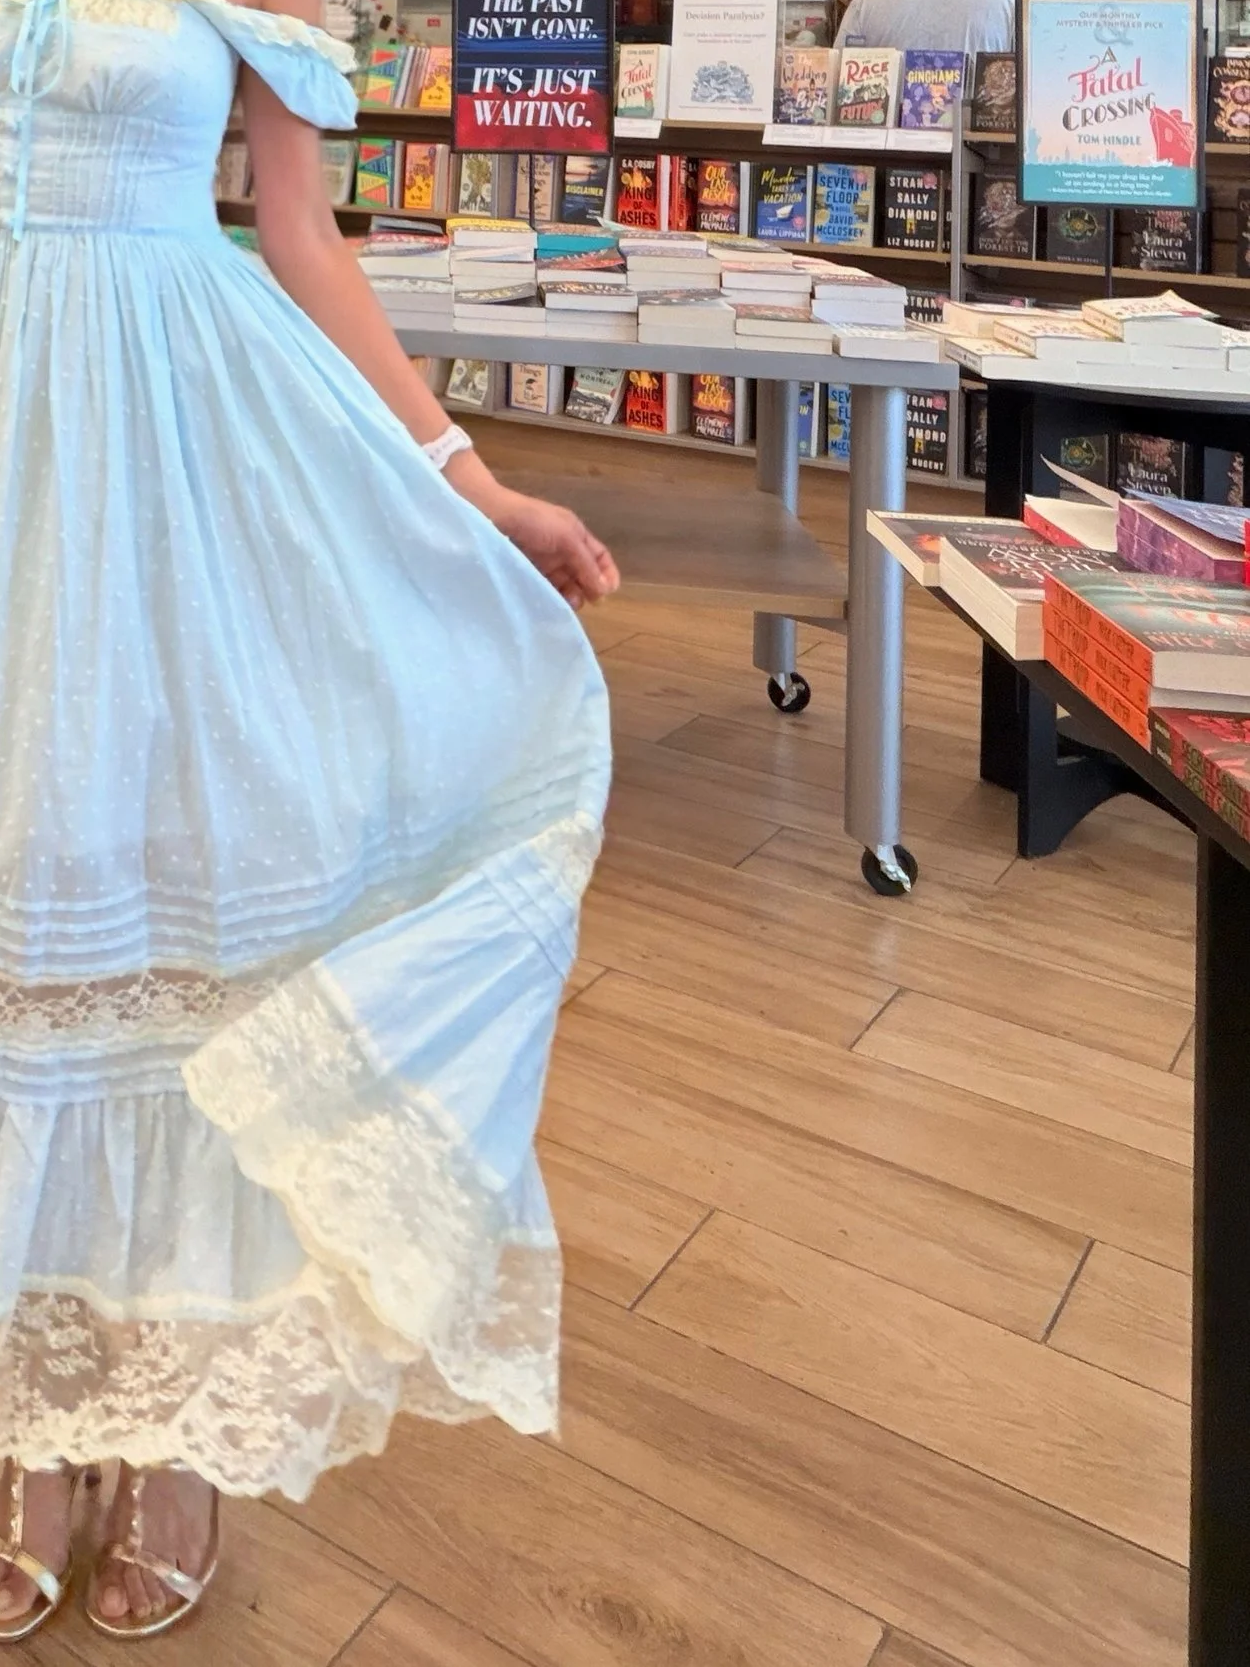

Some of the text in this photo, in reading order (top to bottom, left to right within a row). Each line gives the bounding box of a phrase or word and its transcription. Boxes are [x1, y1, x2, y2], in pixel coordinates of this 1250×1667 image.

[685, 11, 765, 22] Decision Paralysis?
[1079, 11, 1141, 20] OUR MONTHLY
[467, 17, 598, 41] ISN'T GONE.
[1056, 20, 1093, 29] MYSTERY
[1103, 21, 1143, 29] THRILLER
[1101, 46, 1118, 63] A
[783, 65, 827, 85] Wedding
[845, 60, 890, 85] RACE
[907, 69, 960, 84] GINGHAMS
[1068, 56, 1147, 103] Fatal
[472, 67, 596, 98] IT'S JUST
[473, 99, 592, 128] WAITING.
[1077, 134, 1142, 146] TOM HINDLE
[634, 159, 656, 170] COSBY
[706, 165, 727, 182] OUR
[761, 166, 797, 187] Murder
[1122, 173, 1137, 181] drop
[565, 184, 604, 197] DISCLAIMER
[710, 178, 731, 191] LAST
[624, 187, 654, 201] KING
[702, 188, 735, 205] RESORT
[763, 192, 804, 205] VACATION
[826, 191, 860, 205] FLOOR
[897, 192, 930, 204] SALLY
[633, 201, 642, 209] OF
[620, 210, 656, 226] ASHES
[829, 214, 853, 224] DAVID
[888, 207, 937, 222] DIAMOND
[758, 227, 805, 239] LAURA LIPPMAN
[816, 224, 864, 237] McCLOSKEY
[888, 237, 936, 249] LIZ NUGENT
[1143, 231, 1183, 248] Laura
[979, 242, 1029, 253] FOREST IN
[1140, 247, 1187, 261] Steven
[519, 364, 542, 377] Things
[631, 385, 659, 402] KING
[705, 383, 725, 394] LAST
[640, 400, 650, 410] OF
[628, 409, 663, 428] ASHES
[906, 411, 939, 425] SALLY
[908, 426, 947, 443] AMOND
[912, 457, 944, 471] NUGENT
[1128, 463, 1168, 483] Laura
